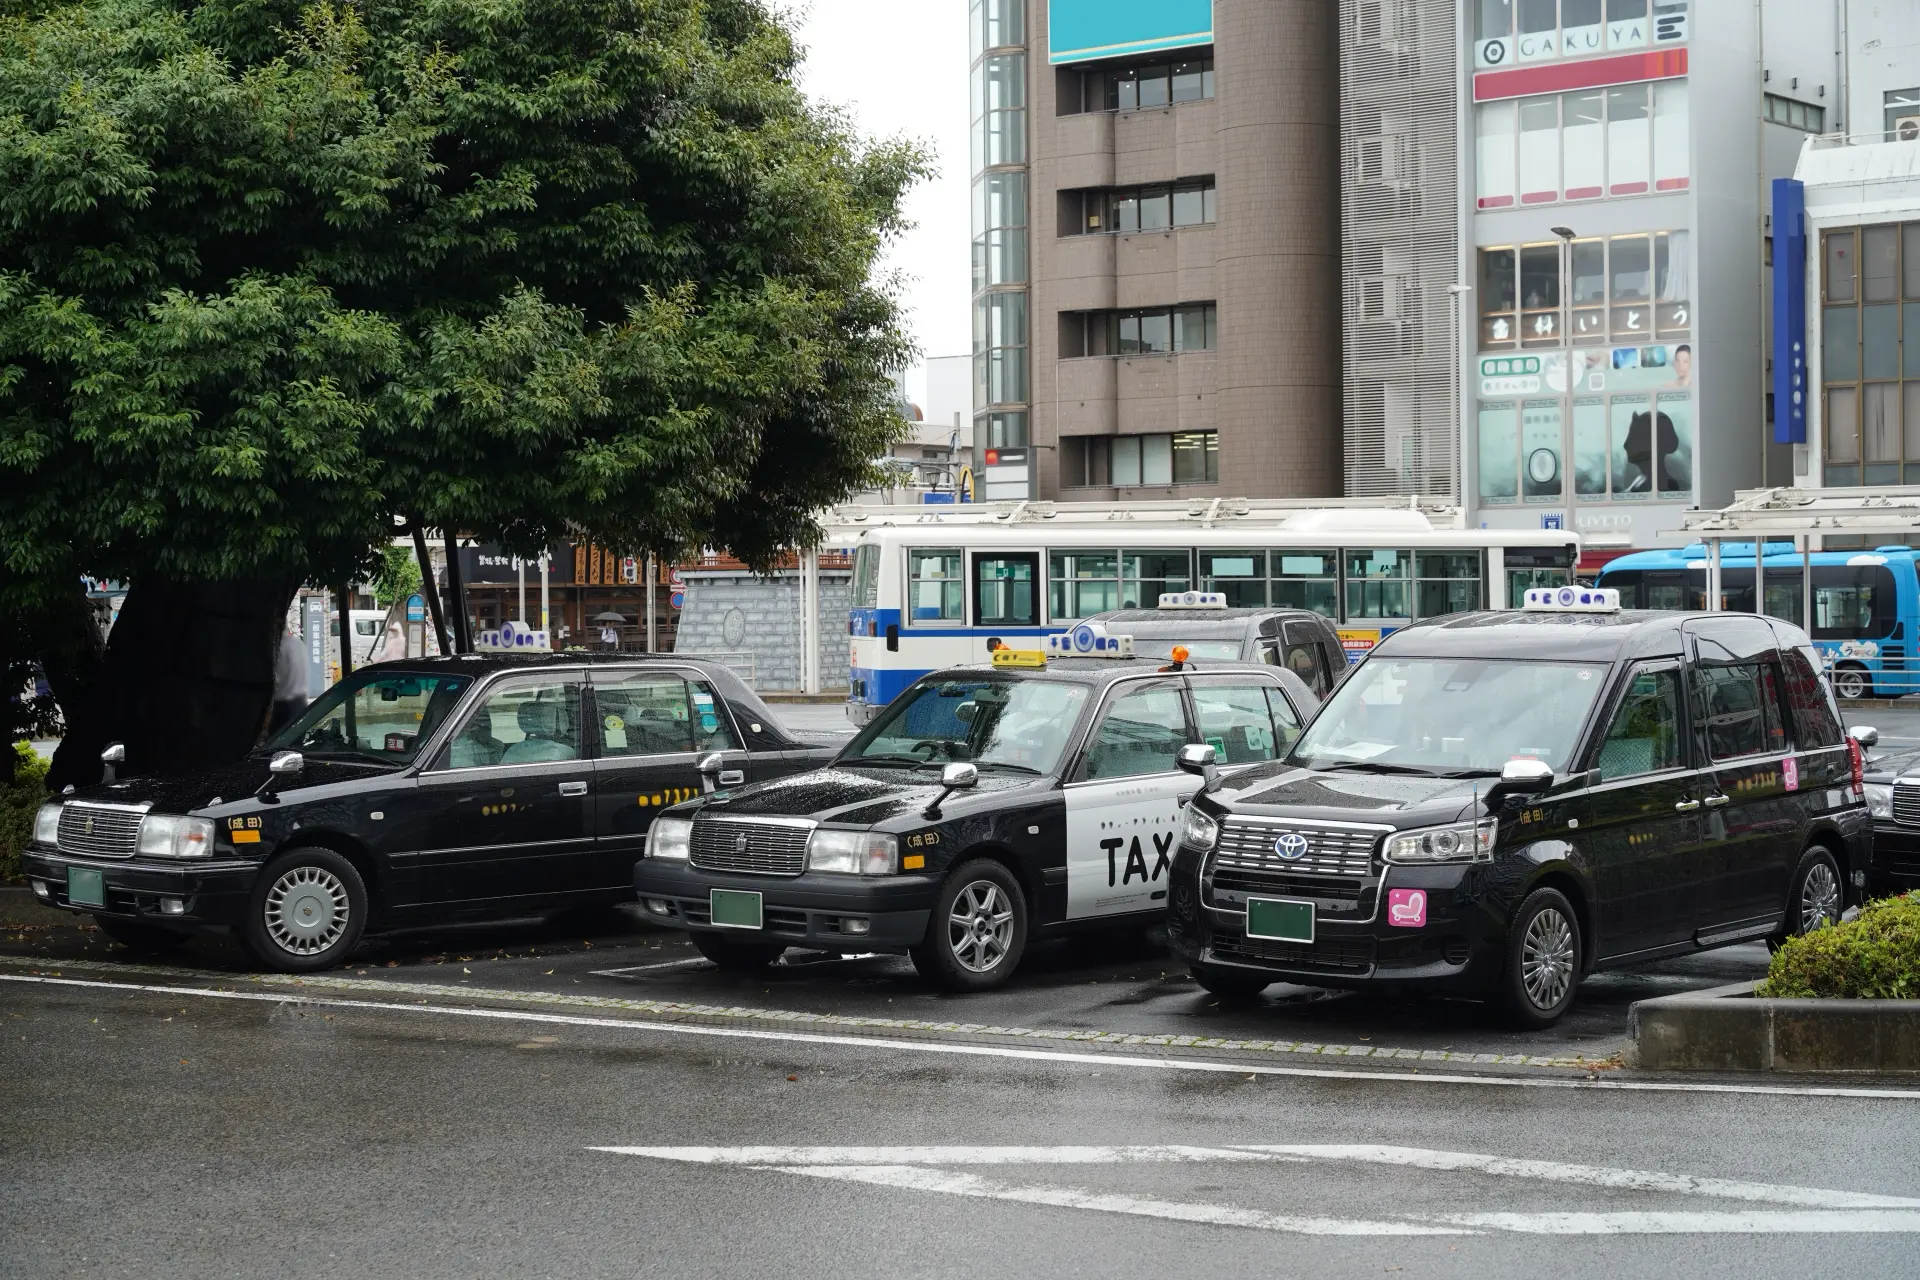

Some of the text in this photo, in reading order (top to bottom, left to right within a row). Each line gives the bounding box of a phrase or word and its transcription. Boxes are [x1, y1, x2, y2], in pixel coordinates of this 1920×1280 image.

[1520, 26, 1642, 57] GAKUYA
[1575, 515, 1632, 528] LIVETO
[312, 620, 320, 664] 一般車乗降場
[227, 815, 263, 830] (成田)
[907, 832, 940, 848] (成田)
[1100, 831, 1174, 888] TAX
